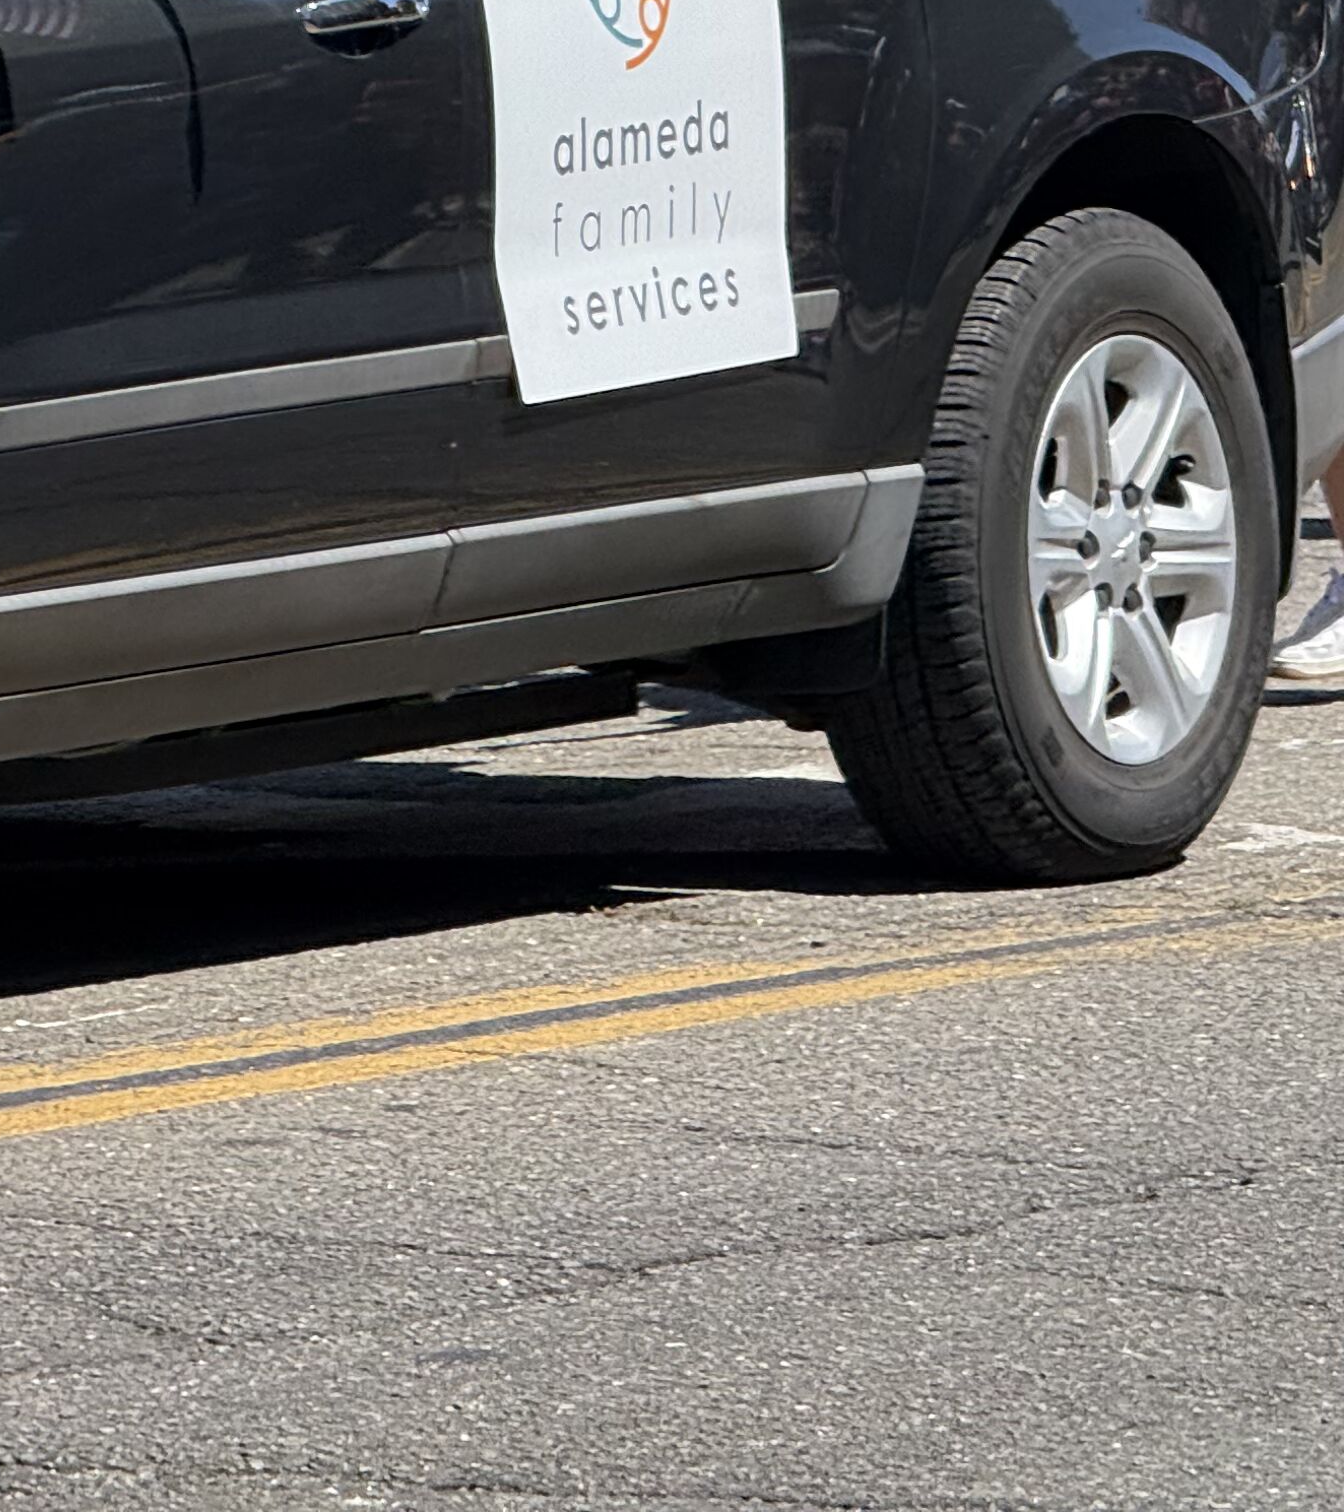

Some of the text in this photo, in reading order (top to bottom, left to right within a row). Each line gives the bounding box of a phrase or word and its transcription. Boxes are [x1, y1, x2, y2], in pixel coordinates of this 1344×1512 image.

[553, 99, 731, 176] alameda
[553, 182, 733, 257] family
[563, 266, 740, 336] services
